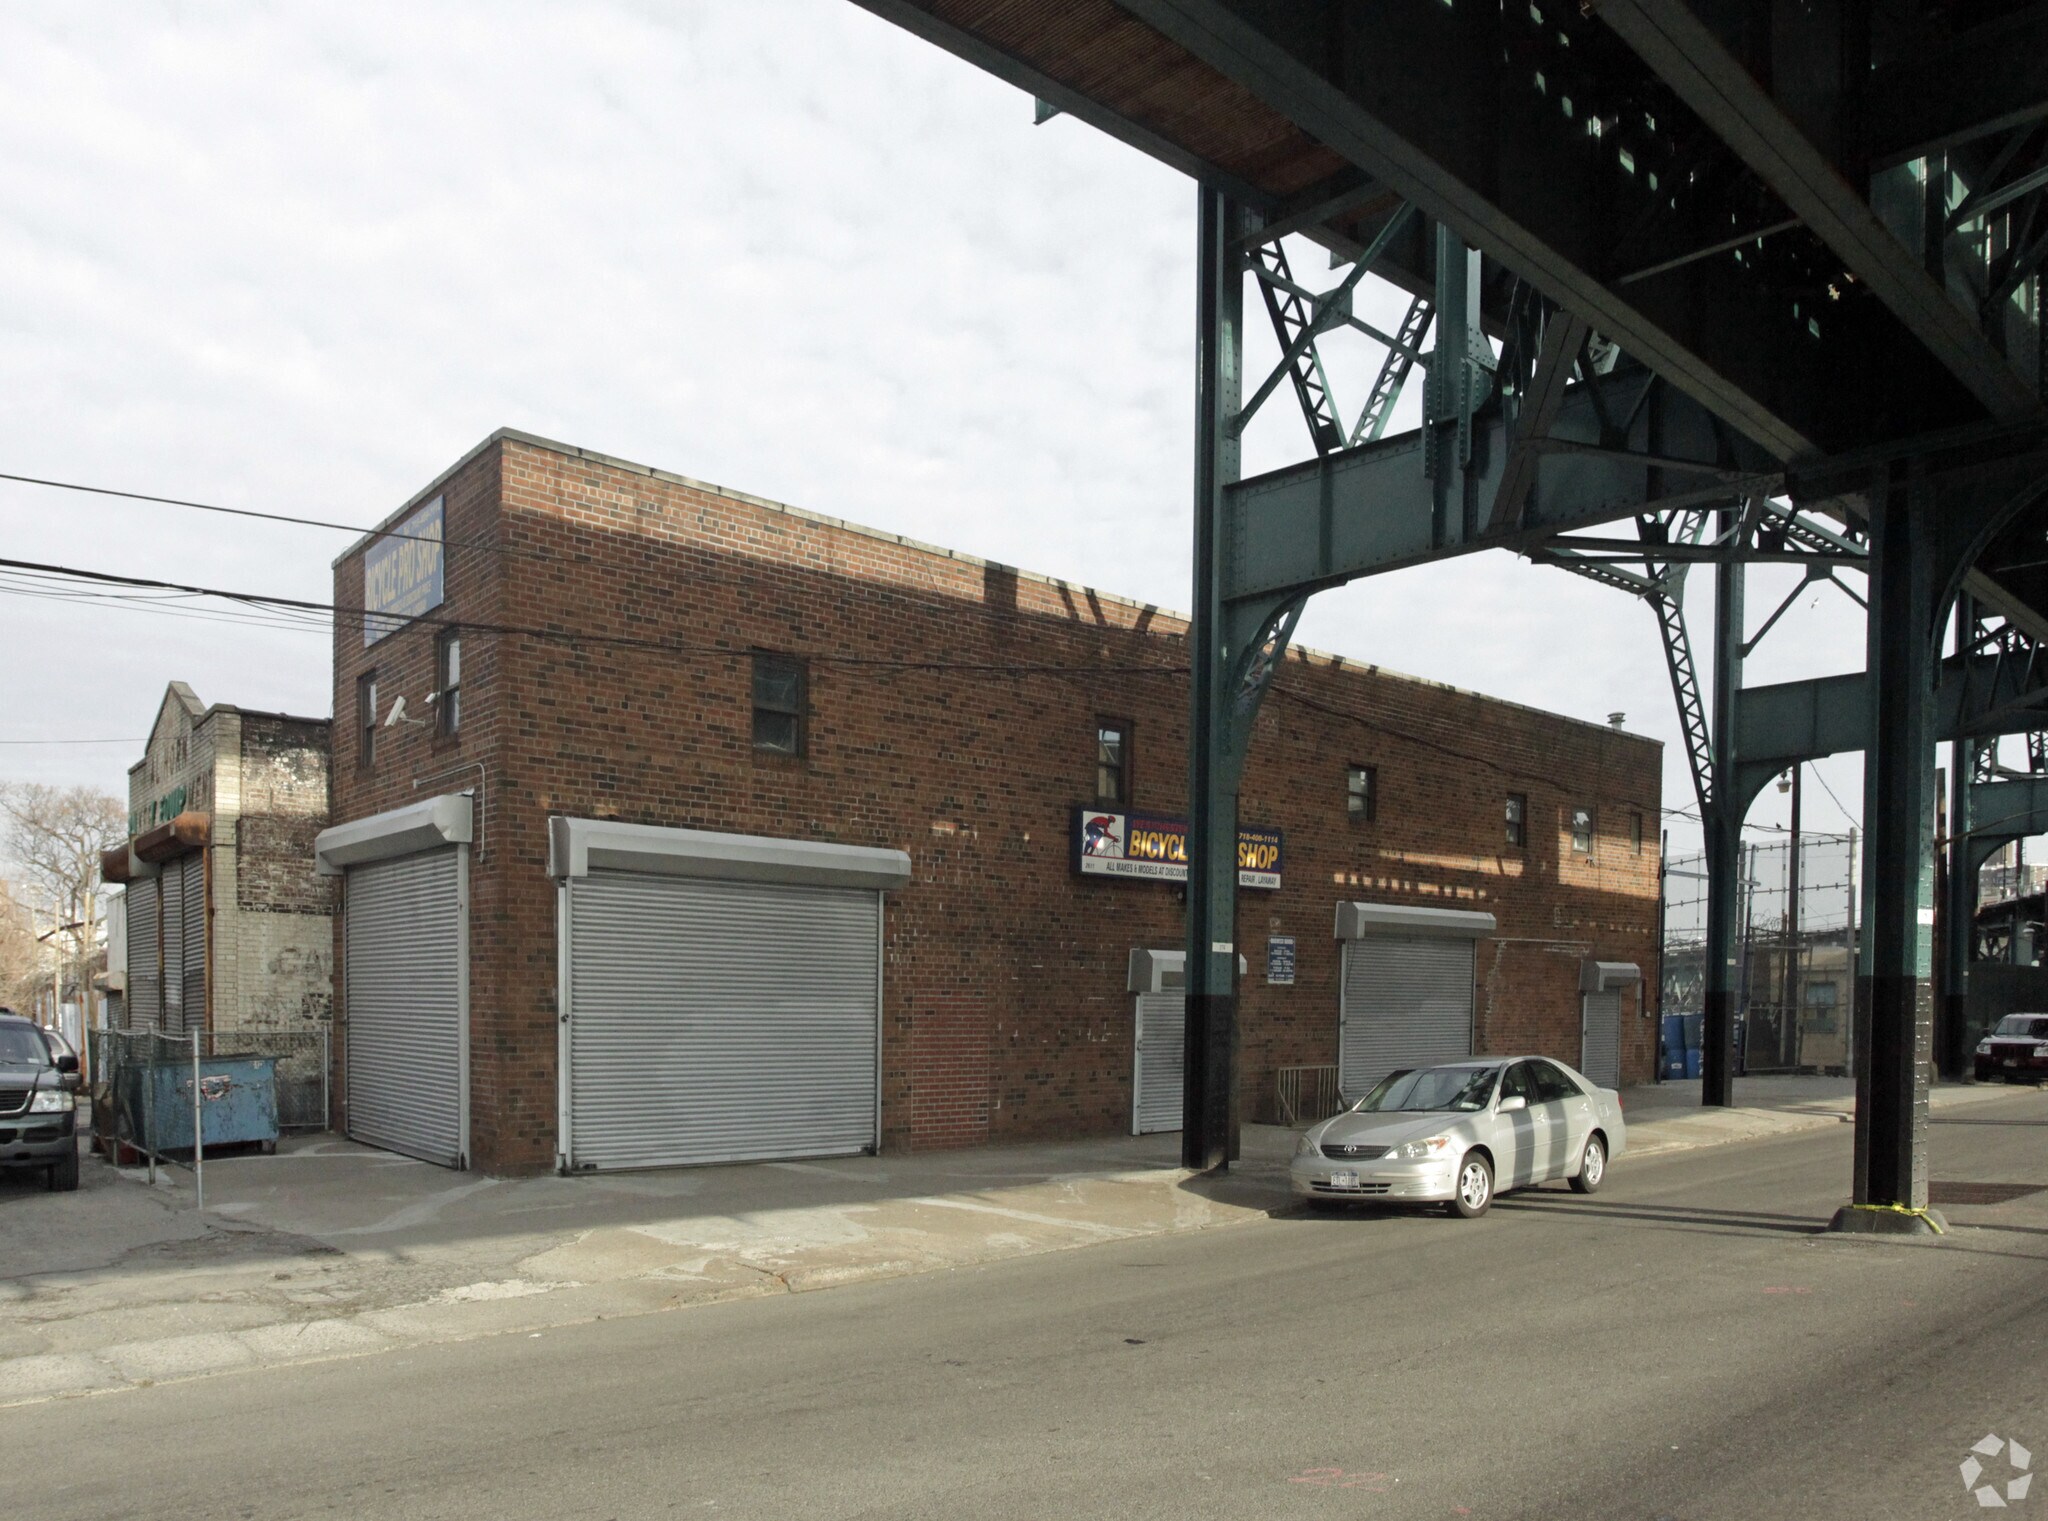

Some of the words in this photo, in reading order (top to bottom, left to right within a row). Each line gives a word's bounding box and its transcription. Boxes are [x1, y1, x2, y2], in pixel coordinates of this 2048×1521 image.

[1129, 830, 1188, 861] BICYCL
[1238, 842, 1278, 869] SHOP
[1106, 862, 1115, 871] ALL
[1116, 863, 1133, 873] MAKES
[1138, 865, 1158, 875] MODELS
[1158, 867, 1165, 875] AT
